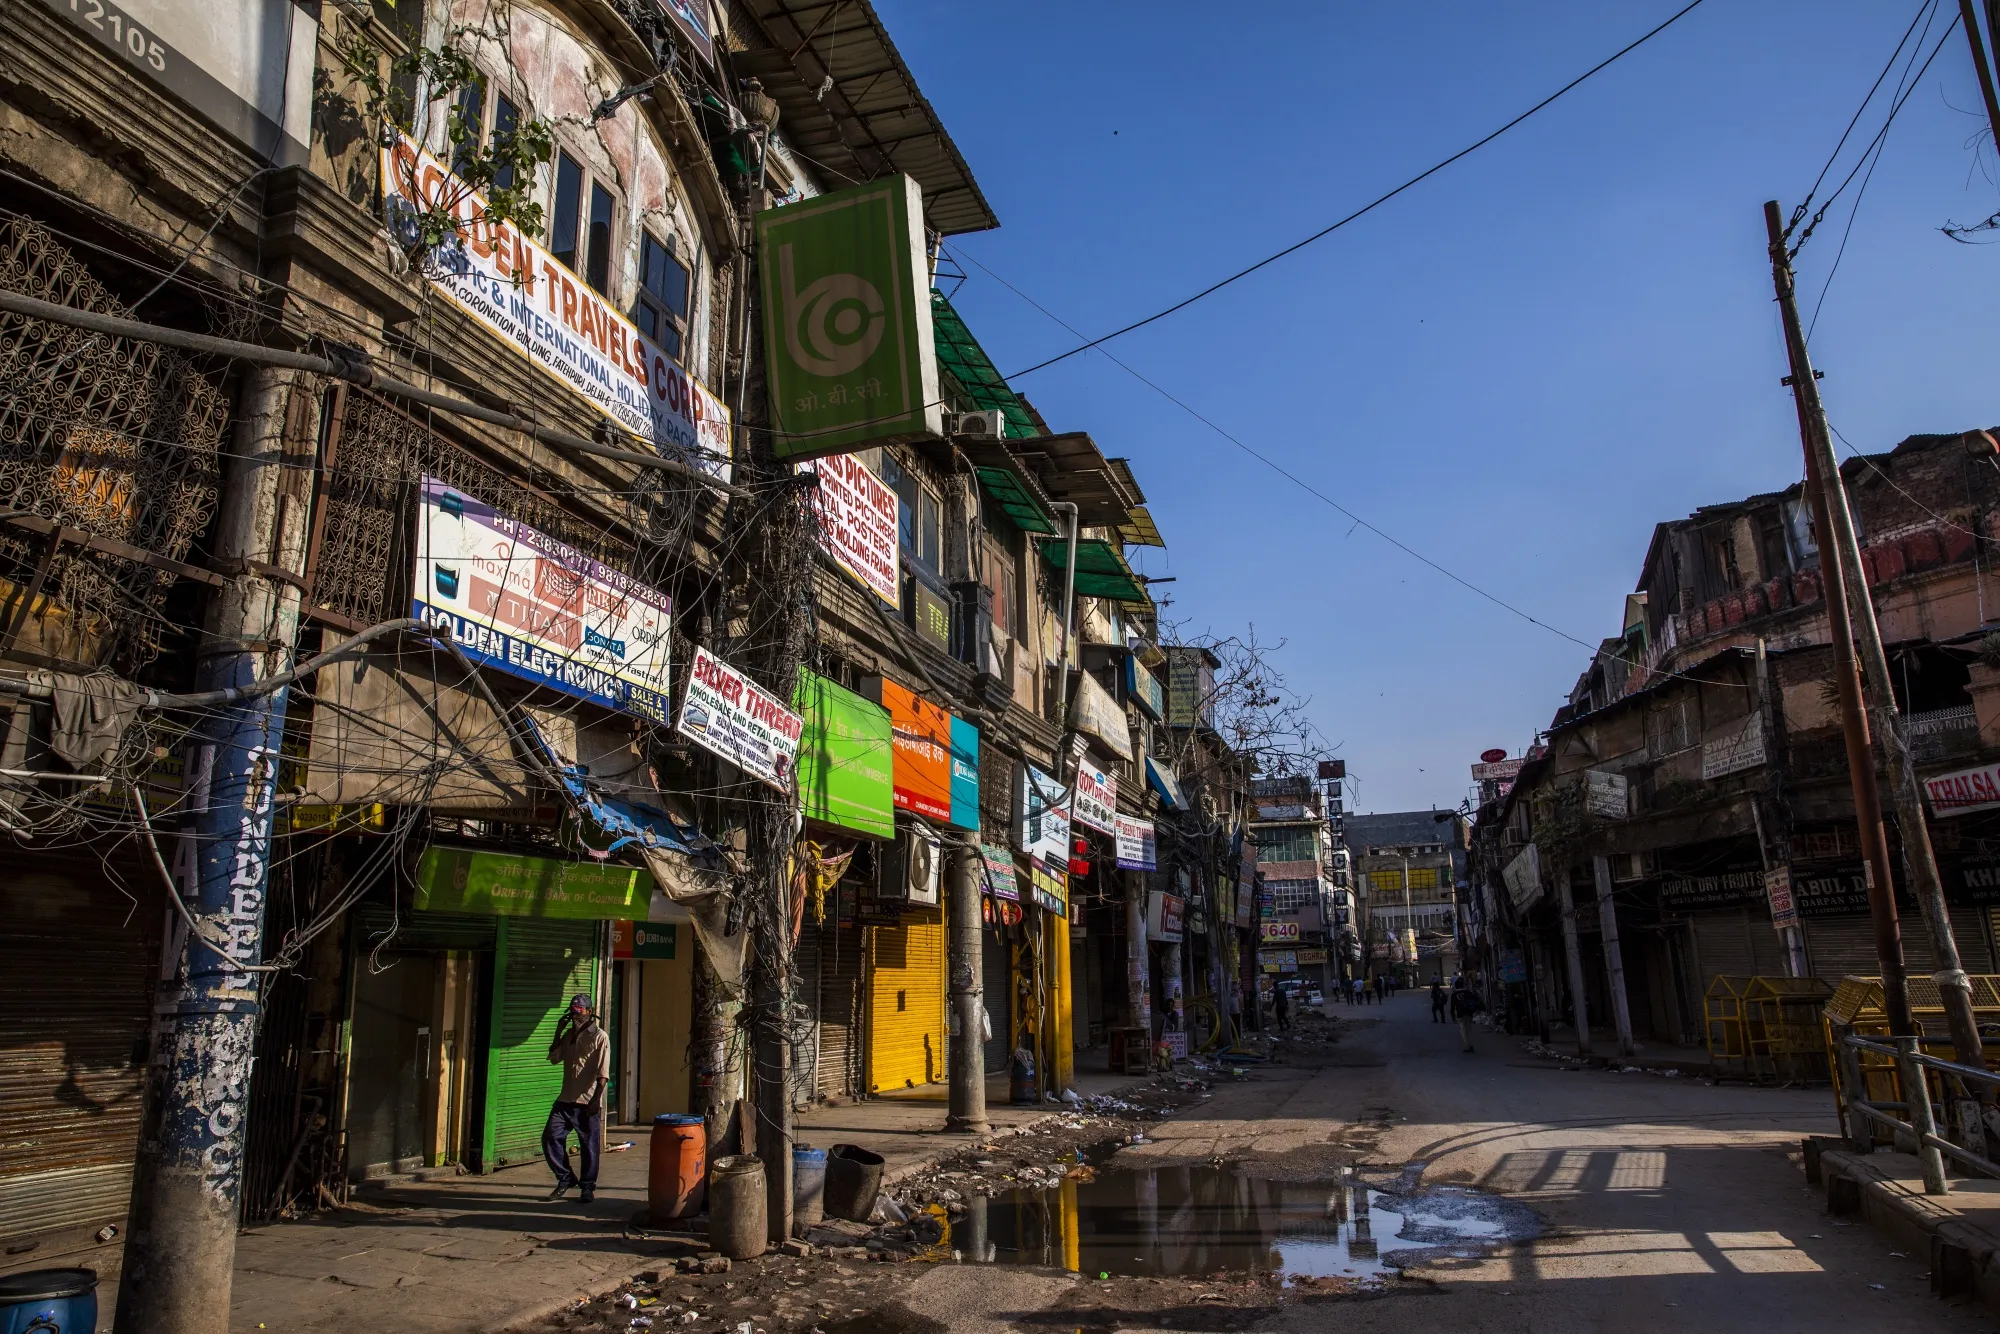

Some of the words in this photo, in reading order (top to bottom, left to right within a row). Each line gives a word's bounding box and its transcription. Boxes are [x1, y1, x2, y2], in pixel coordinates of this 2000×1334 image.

[391, 141, 534, 298] GOLDEN
[543, 260, 649, 387] TRAVELS
[654, 355, 706, 435] CORP.
[491, 281, 506, 309] &
[510, 296, 614, 393] INTERNATIONAL
[617, 378, 663, 427] HOLIDAY
[818, 466, 853, 506] PRINTED
[854, 496, 896, 545] PICTURERS
[845, 453, 895, 525] PICTURES
[493, 512, 514, 533] PH
[847, 511, 891, 560] POSTERS
[472, 552, 531, 592] maxima
[836, 523, 870, 566] MOLDING
[870, 551, 894, 583] FRAMES
[508, 598, 568, 639] TITAN
[421, 606, 503, 660] GOLDEN
[509, 640, 624, 703] ELECTRONICS
[588, 631, 623, 655] SONATA
[627, 700, 665, 722] SERVICE
[631, 687, 654, 704] SALE
[655, 696, 662, 708] &
[690, 683, 732, 717] WHOLESALE
[732, 711, 747, 728] AND
[747, 721, 772, 743] RETAIL
[694, 654, 743, 709] SILVER
[745, 687, 801, 741] THREAD
[1079, 769, 1095, 797] GOPI
[1928, 771, 1996, 802] KHALSA
[491, 882, 541, 901] ORIENTAL
[574, 892, 584, 903] OF
[1661, 878, 1696, 896] GOPAL
[1698, 875, 1719, 892] DRY
[1721, 870, 1765, 891] FRUITS
[1269, 924, 1297, 937] 640
